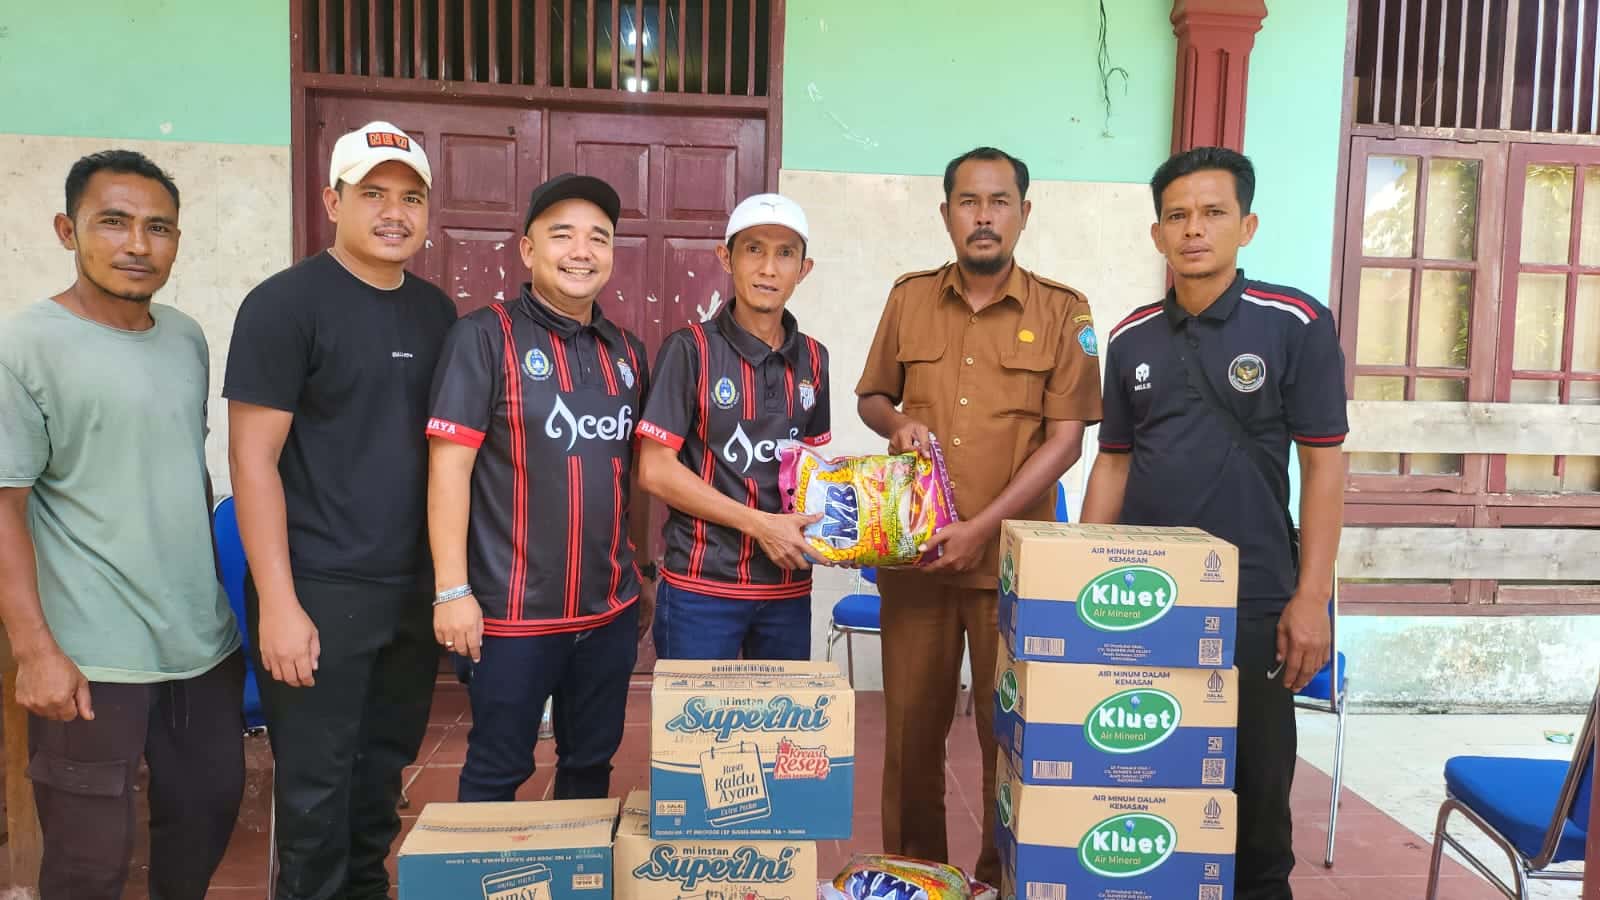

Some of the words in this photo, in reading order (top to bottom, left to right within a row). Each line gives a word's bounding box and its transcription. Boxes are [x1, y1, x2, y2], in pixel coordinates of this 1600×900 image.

[545, 393, 632, 451] Aceh
[820, 484, 861, 543] MB
[1091, 547, 1105, 555] AIR
[1106, 548, 1135, 556] MINUM
[1136, 549, 1166, 557] DALAM
[1108, 556, 1148, 564] KEMASAN
[1092, 584, 1167, 608] Kluet
[1093, 608, 1106, 618] Air
[1107, 609, 1141, 619] Mineral
[1142, 671, 1170, 679] DALAM
[1115, 678, 1153, 686] KEMASAN
[1099, 707, 1171, 730] Kluet
[1101, 732, 1113, 740] Air
[1115, 731, 1146, 741] Mineral
[790, 748, 822, 758] Kreasi
[723, 763, 744, 775] Rasa
[777, 755, 828, 774] Resep
[714, 771, 755, 791] Kaldu
[719, 785, 759, 804] Ayam
[1137, 796, 1166, 804] DALAM
[1109, 803, 1149, 811] KEMASAN
[1092, 831, 1167, 855] Kluet
[682, 847, 695, 856] mi
[697, 846, 729, 856] instan
[1094, 855, 1107, 863] Air
[1109, 856, 1141, 865] Mineral
